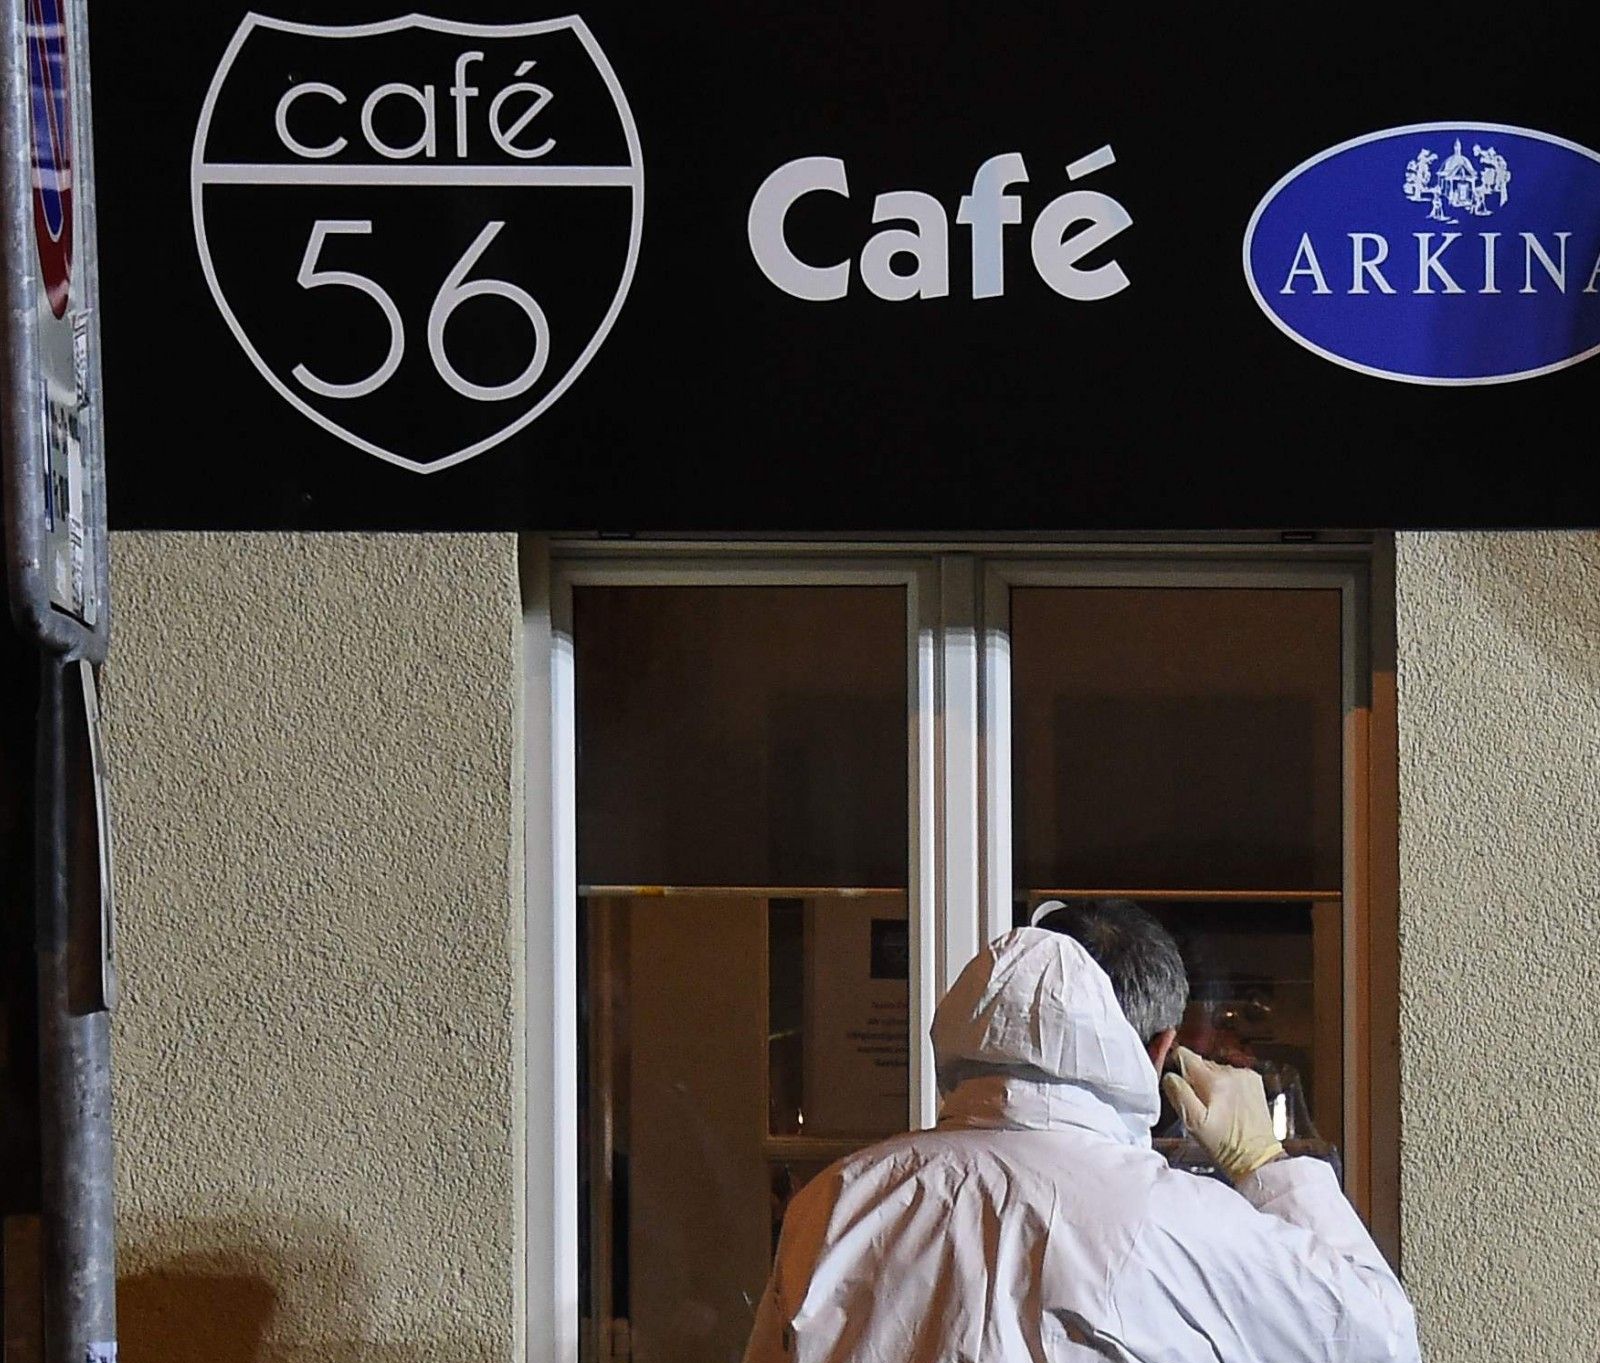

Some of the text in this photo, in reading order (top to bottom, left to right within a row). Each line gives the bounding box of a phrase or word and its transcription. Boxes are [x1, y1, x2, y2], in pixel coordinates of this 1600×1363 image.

[275, 51, 557, 159] café
[747, 144, 1134, 302] Café
[290, 219, 551, 401] 56
